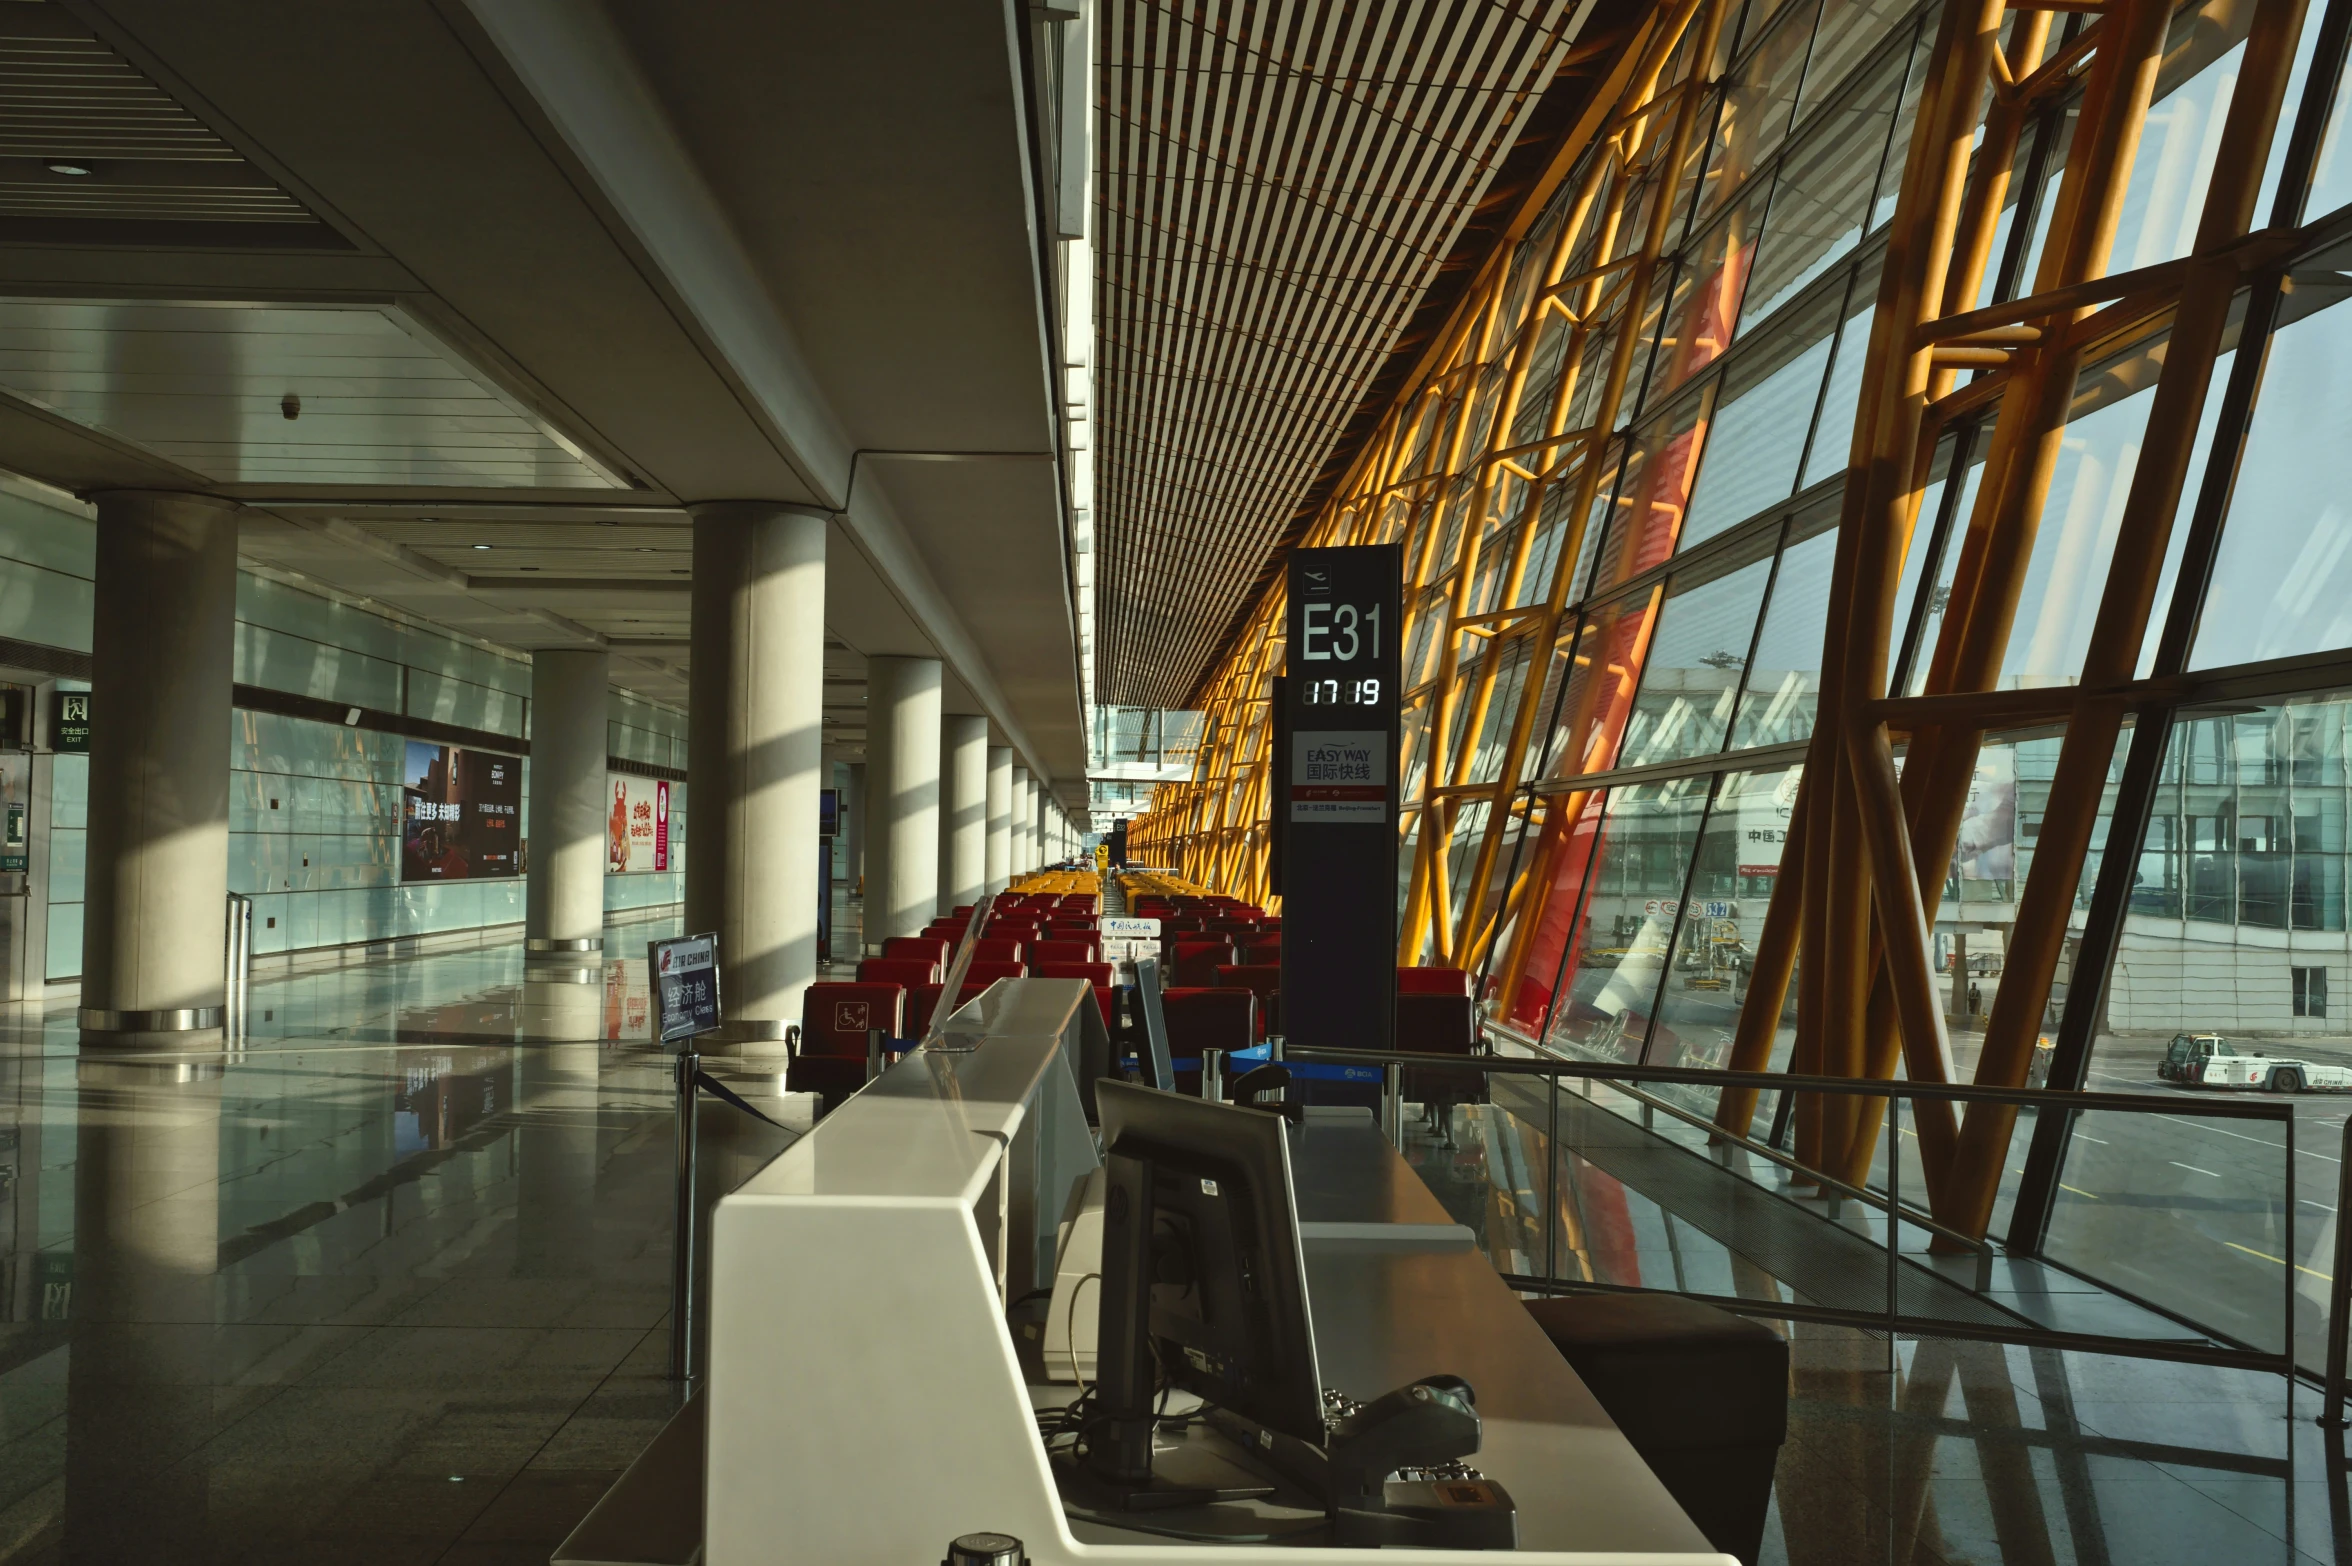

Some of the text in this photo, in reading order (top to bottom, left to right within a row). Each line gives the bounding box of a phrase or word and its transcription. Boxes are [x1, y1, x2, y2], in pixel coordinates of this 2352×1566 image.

[1303, 602, 1380, 661] E31
[60, 727, 89, 736] 安全出口
[1307, 748, 1372, 762] EASY WAY
[1306, 763, 1371, 780] 国际快线
[673, 950, 710, 969] AIR CHINA
[667, 980, 707, 1008] 经济舱
[662, 1004, 713, 1024] Economy Class
[1356, 1070, 1373, 1078] BCIA
